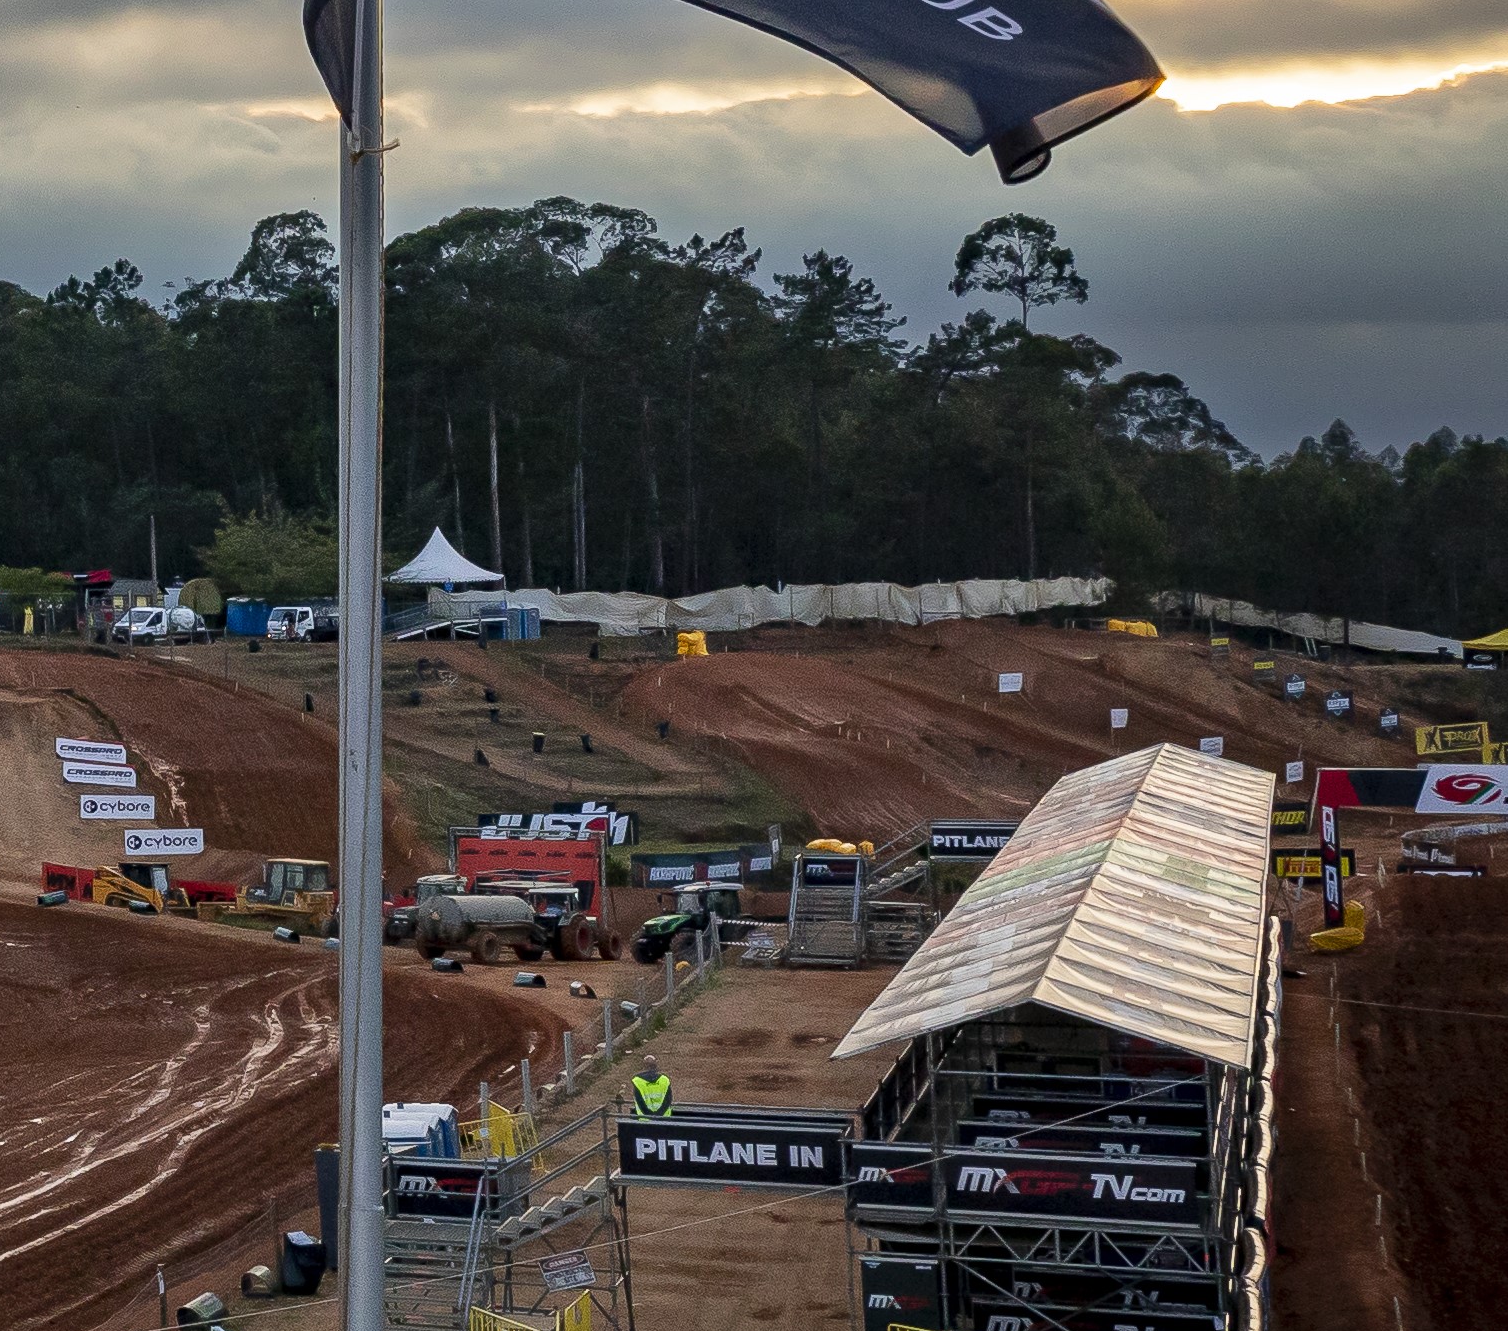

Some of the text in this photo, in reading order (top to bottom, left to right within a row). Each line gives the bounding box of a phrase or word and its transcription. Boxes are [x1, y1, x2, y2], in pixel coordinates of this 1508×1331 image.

[60, 745, 123, 755] CROSSPRO
[67, 768, 132, 778] CROSSPRO
[100, 800, 150, 813] cybore
[144, 835, 198, 849] cybore
[635, 1138, 824, 1168] PITLANE IN
